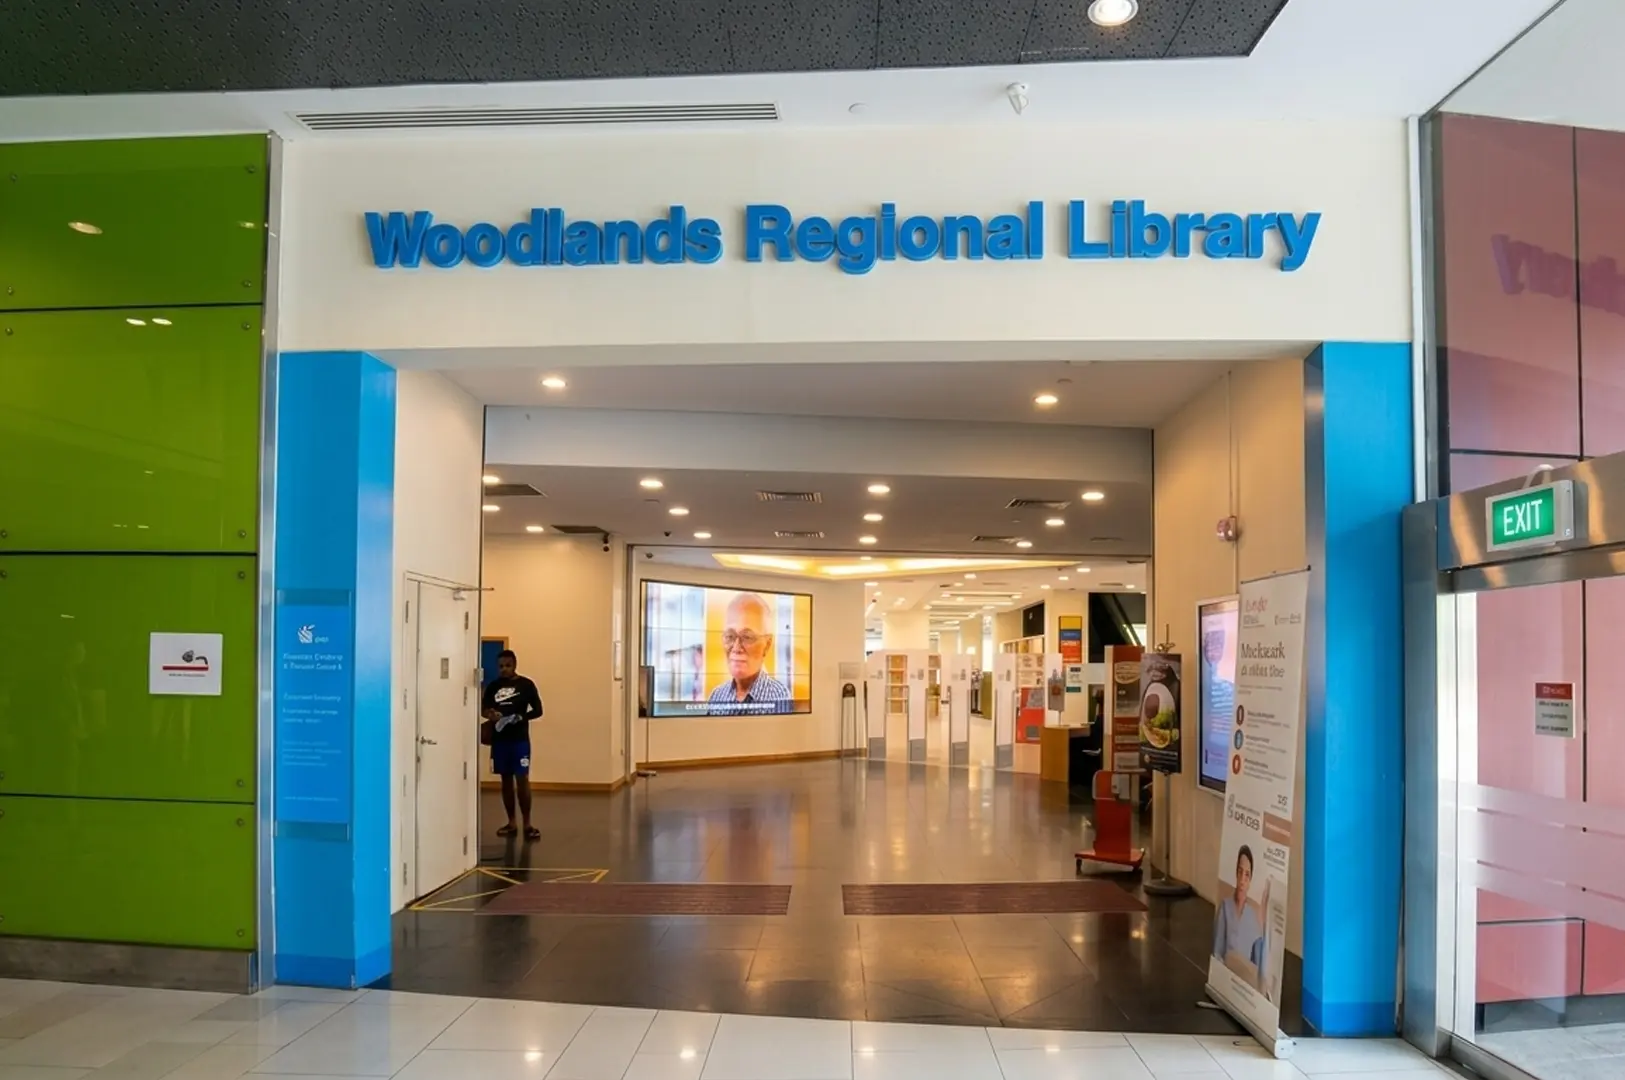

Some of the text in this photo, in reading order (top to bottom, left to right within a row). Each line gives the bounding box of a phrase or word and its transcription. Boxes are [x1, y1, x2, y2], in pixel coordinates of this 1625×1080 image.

[364, 199, 1322, 274] Woodlands Regional Library
[1503, 499, 1543, 536] EXIT
